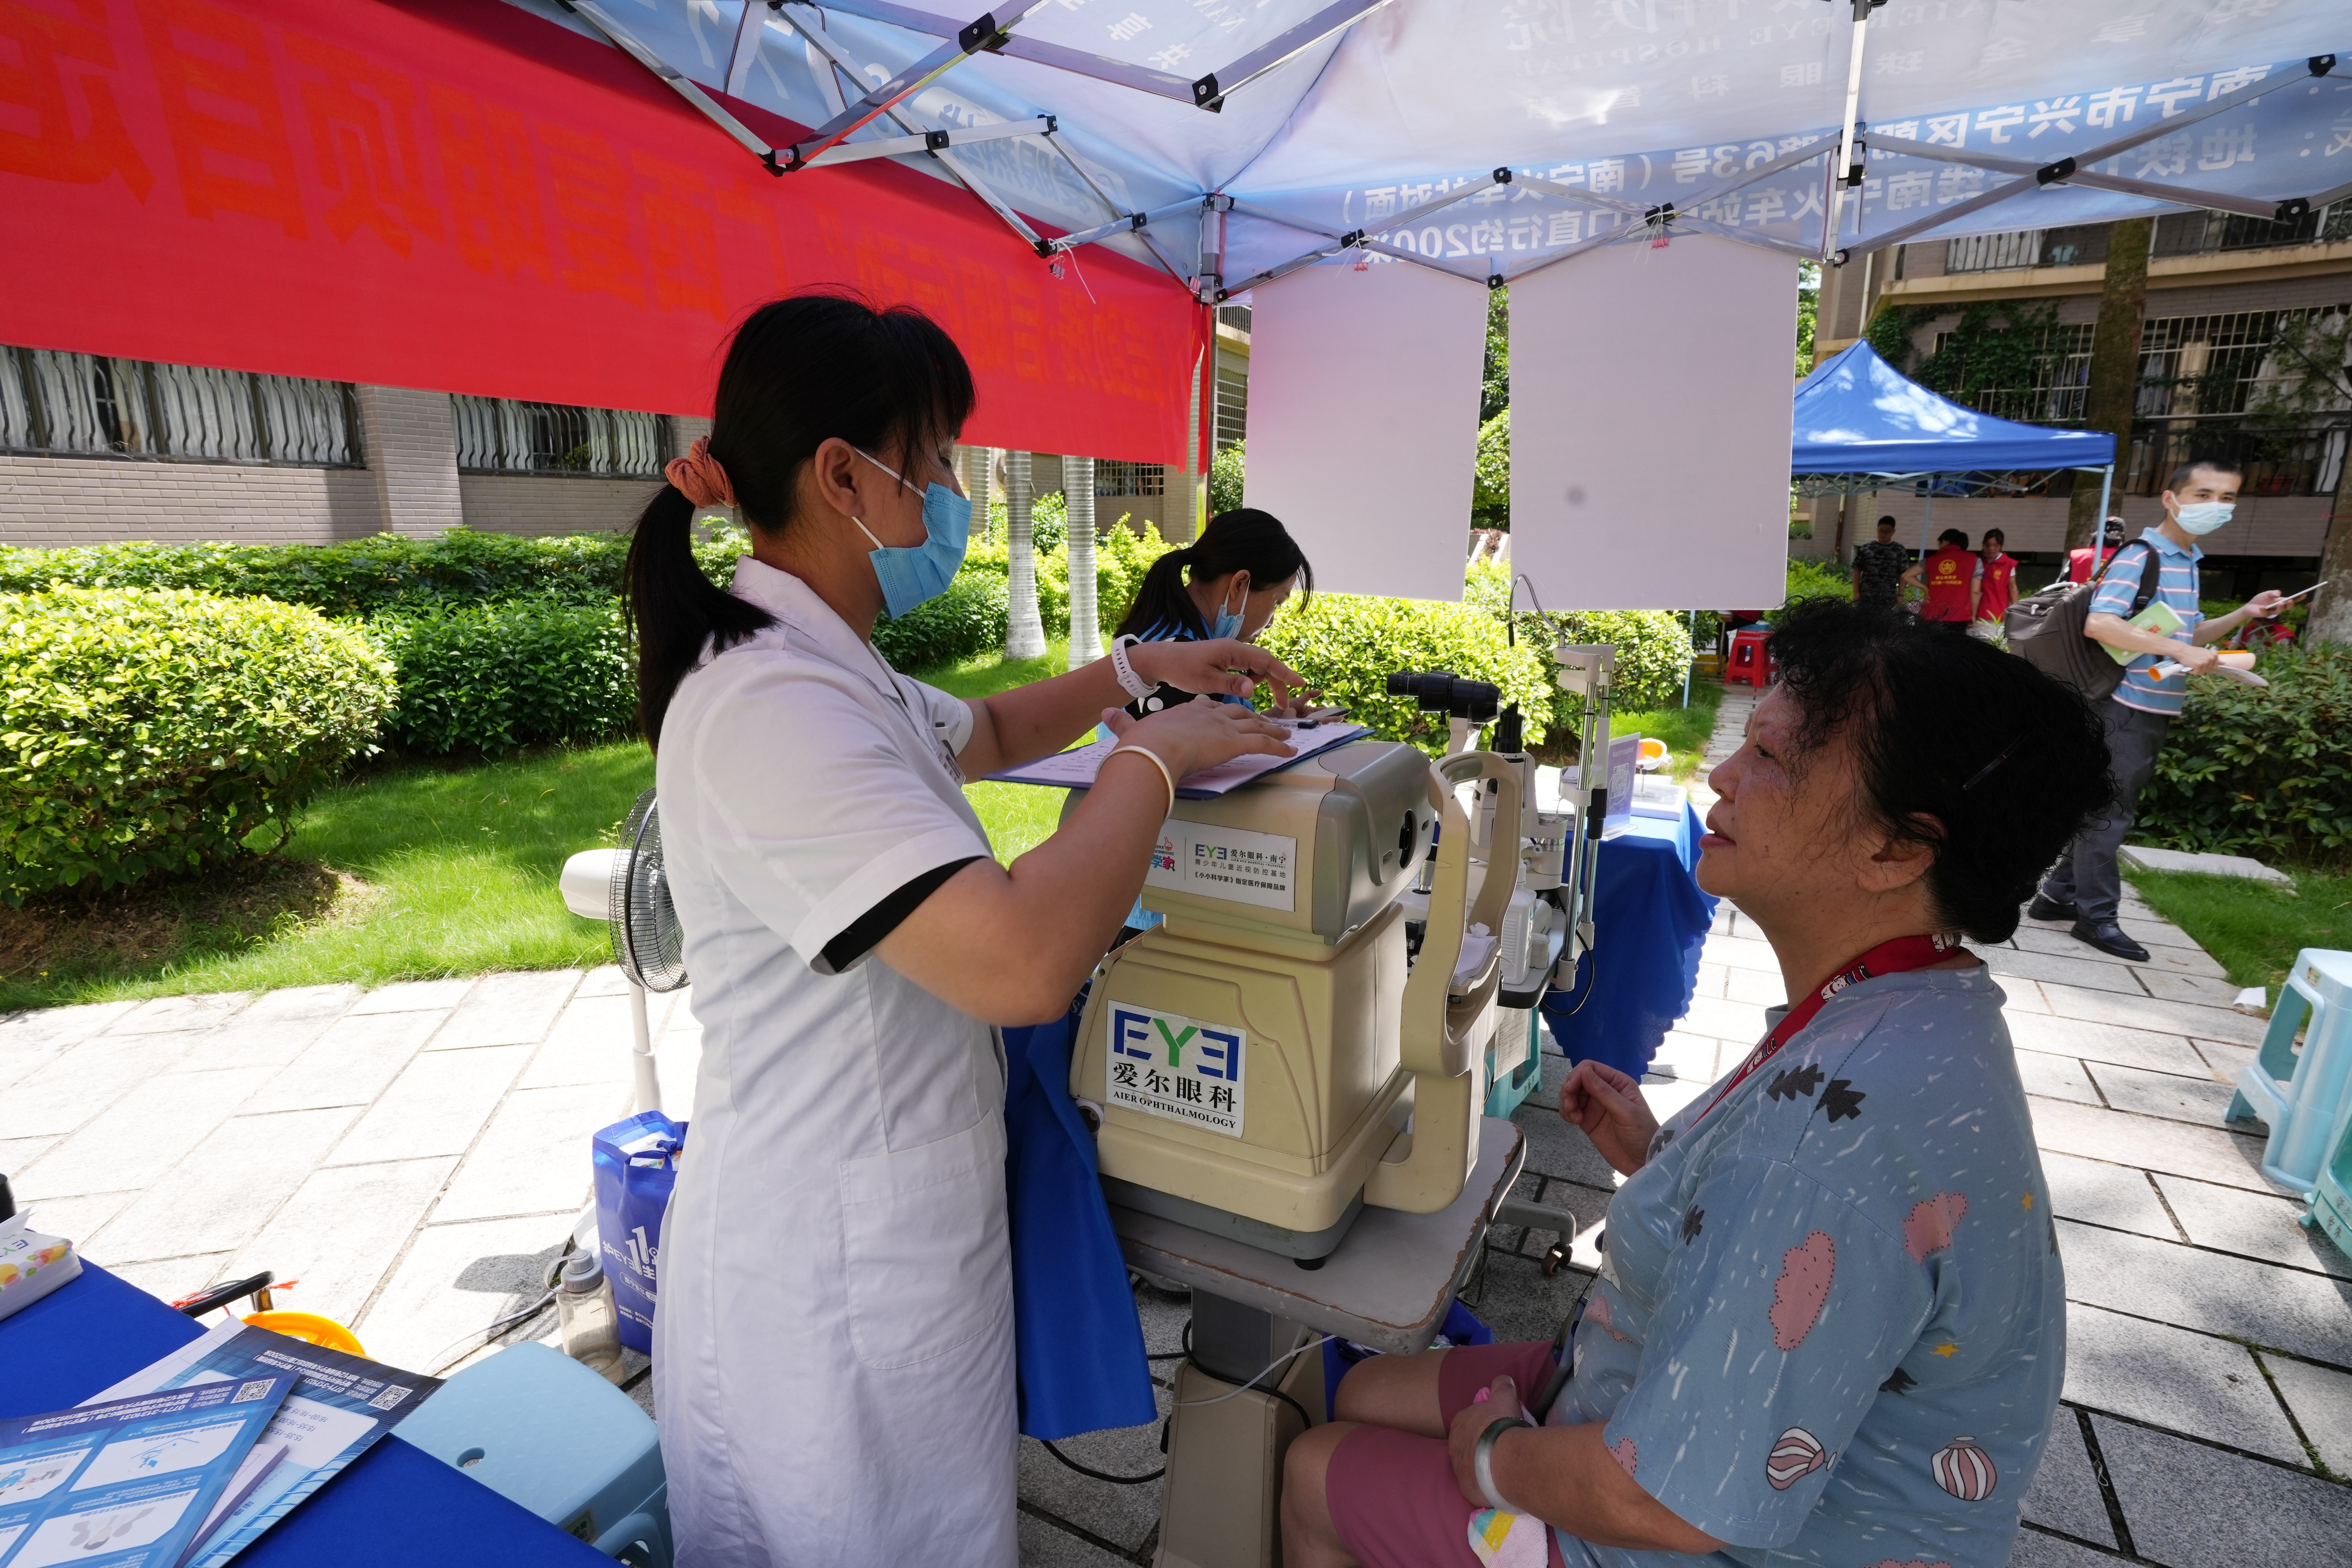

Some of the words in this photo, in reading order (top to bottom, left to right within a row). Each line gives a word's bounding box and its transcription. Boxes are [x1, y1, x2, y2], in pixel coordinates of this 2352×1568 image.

[1195, 844, 1227, 860] EYE
[1231, 849, 1286, 864] 爱尔眼科·南宁
[1195, 859, 1286, 878] 青少年儿童近视防控基地
[1195, 871, 1286, 891] 《小小科学家》指定医疗保障品牌
[1114, 1009, 1240, 1082] EYE
[1113, 1062, 1237, 1113] 爱尔眼科
[1113, 1090, 1137, 1103] AIER
[1139, 1097, 1237, 1129] OPHTHALMOLOGY
[302, 1377, 345, 1393] 0771-3131031
[118, 1405, 185, 1421] 0771-3131031
[290, 1409, 328, 1423] 16:00-16:15
[278, 1417, 316, 1432] 15:55-16:00
[265, 1426, 304, 1442] 15:35-15:55
